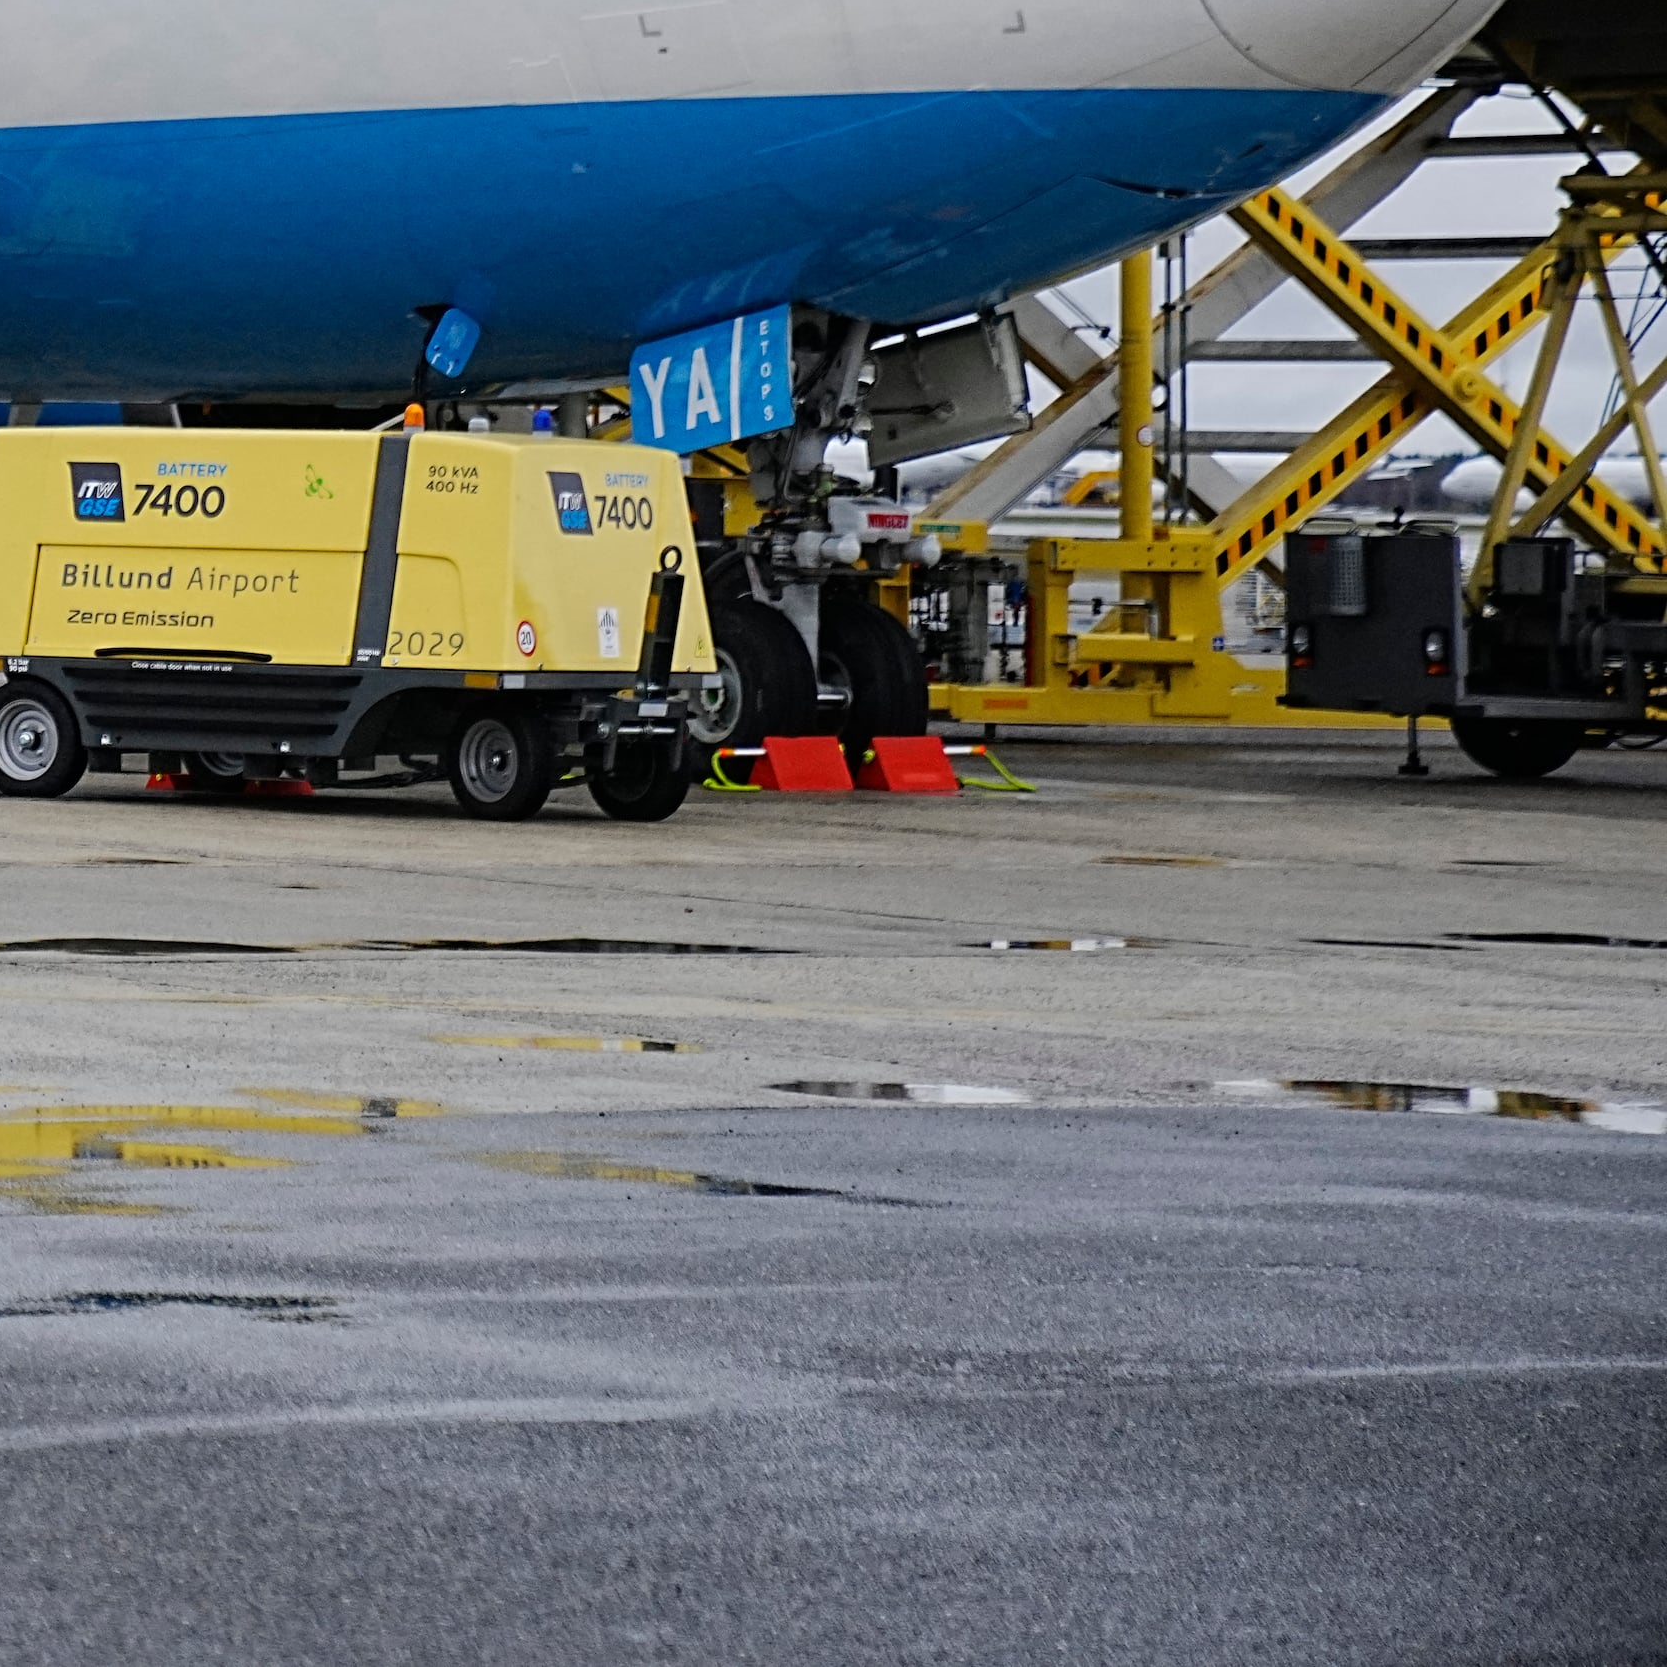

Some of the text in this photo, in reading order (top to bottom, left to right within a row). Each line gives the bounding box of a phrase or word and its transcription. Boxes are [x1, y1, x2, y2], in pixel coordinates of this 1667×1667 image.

[759, 320, 774, 421] ETOPS
[639, 347, 722, 439] YA
[157, 463, 228, 477] BATTERY
[428, 465, 447, 478] 90
[426, 481, 479, 494] 400 Hz
[605, 473, 649, 488] BATTERY
[78, 482, 119, 499] ITW
[78, 498, 121, 516] GSE
[132, 484, 226, 519] 7400
[558, 491, 583, 510] ITW
[594, 496, 653, 530] 7400
[61, 563, 300, 598] Billund Airport
[67, 609, 215, 628] Zero Emission
[389, 631, 465, 657] 2029
[520, 631, 532, 646] 20
[131, 661, 148, 669] Close
[150, 662, 167, 670] cable
[168, 662, 183, 670] door
[184, 663, 201, 671] when
